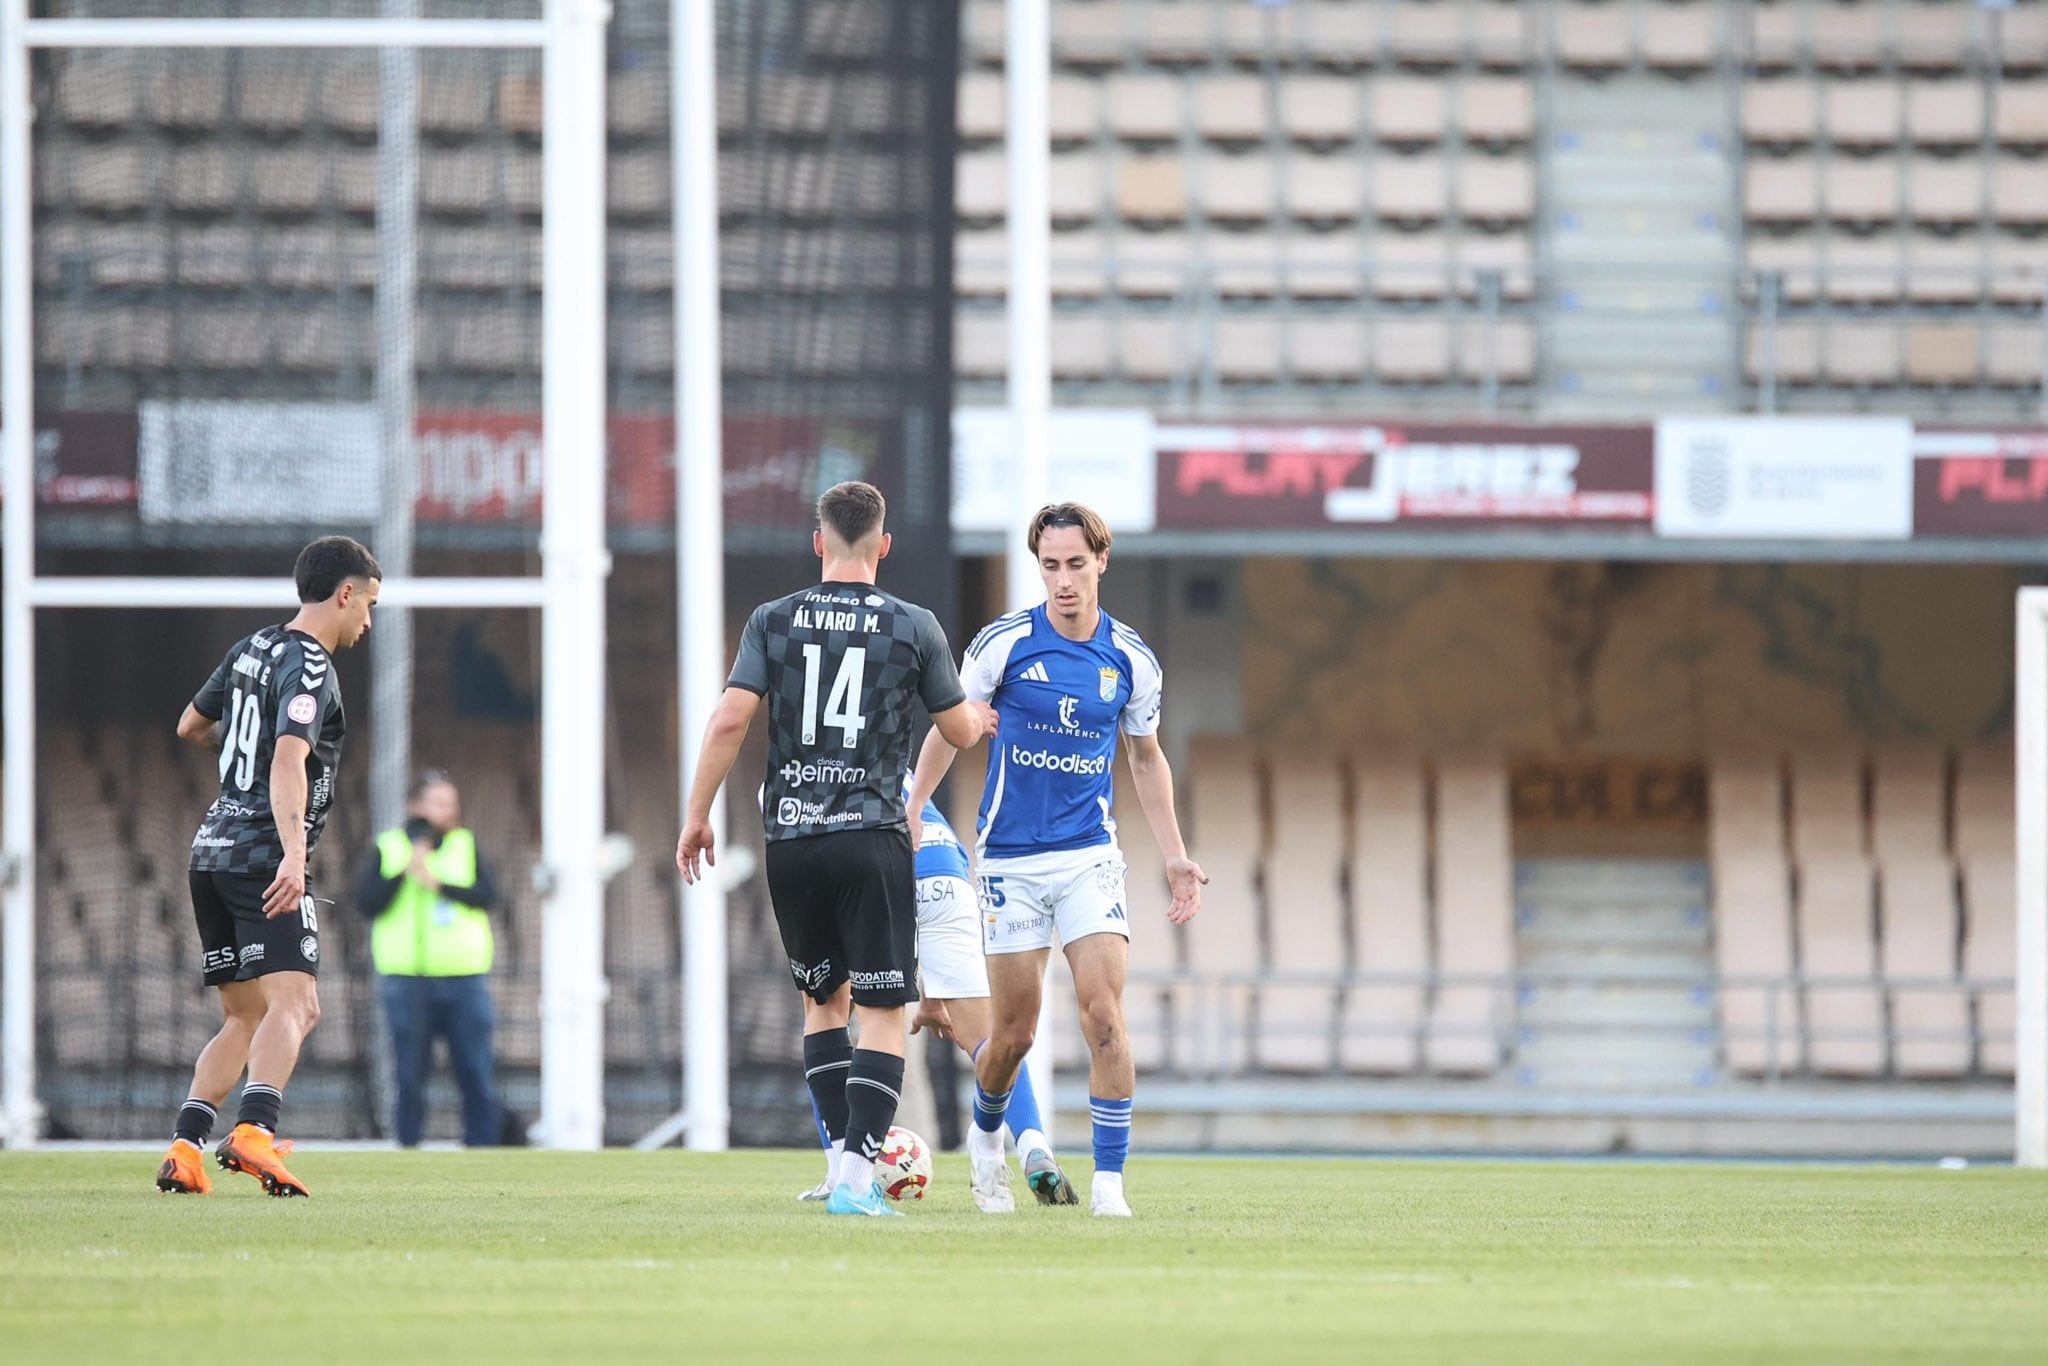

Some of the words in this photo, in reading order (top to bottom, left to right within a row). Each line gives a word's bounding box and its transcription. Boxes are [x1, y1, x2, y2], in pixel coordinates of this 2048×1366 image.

[793, 605, 857, 632] ÁLVARO
[863, 614, 881, 633] M.
[801, 643, 867, 749] 14
[218, 687, 261, 792] 19
[800, 811, 862, 825] ProNutrition
[802, 802, 825, 815] High
[300, 895, 318, 932] 19
